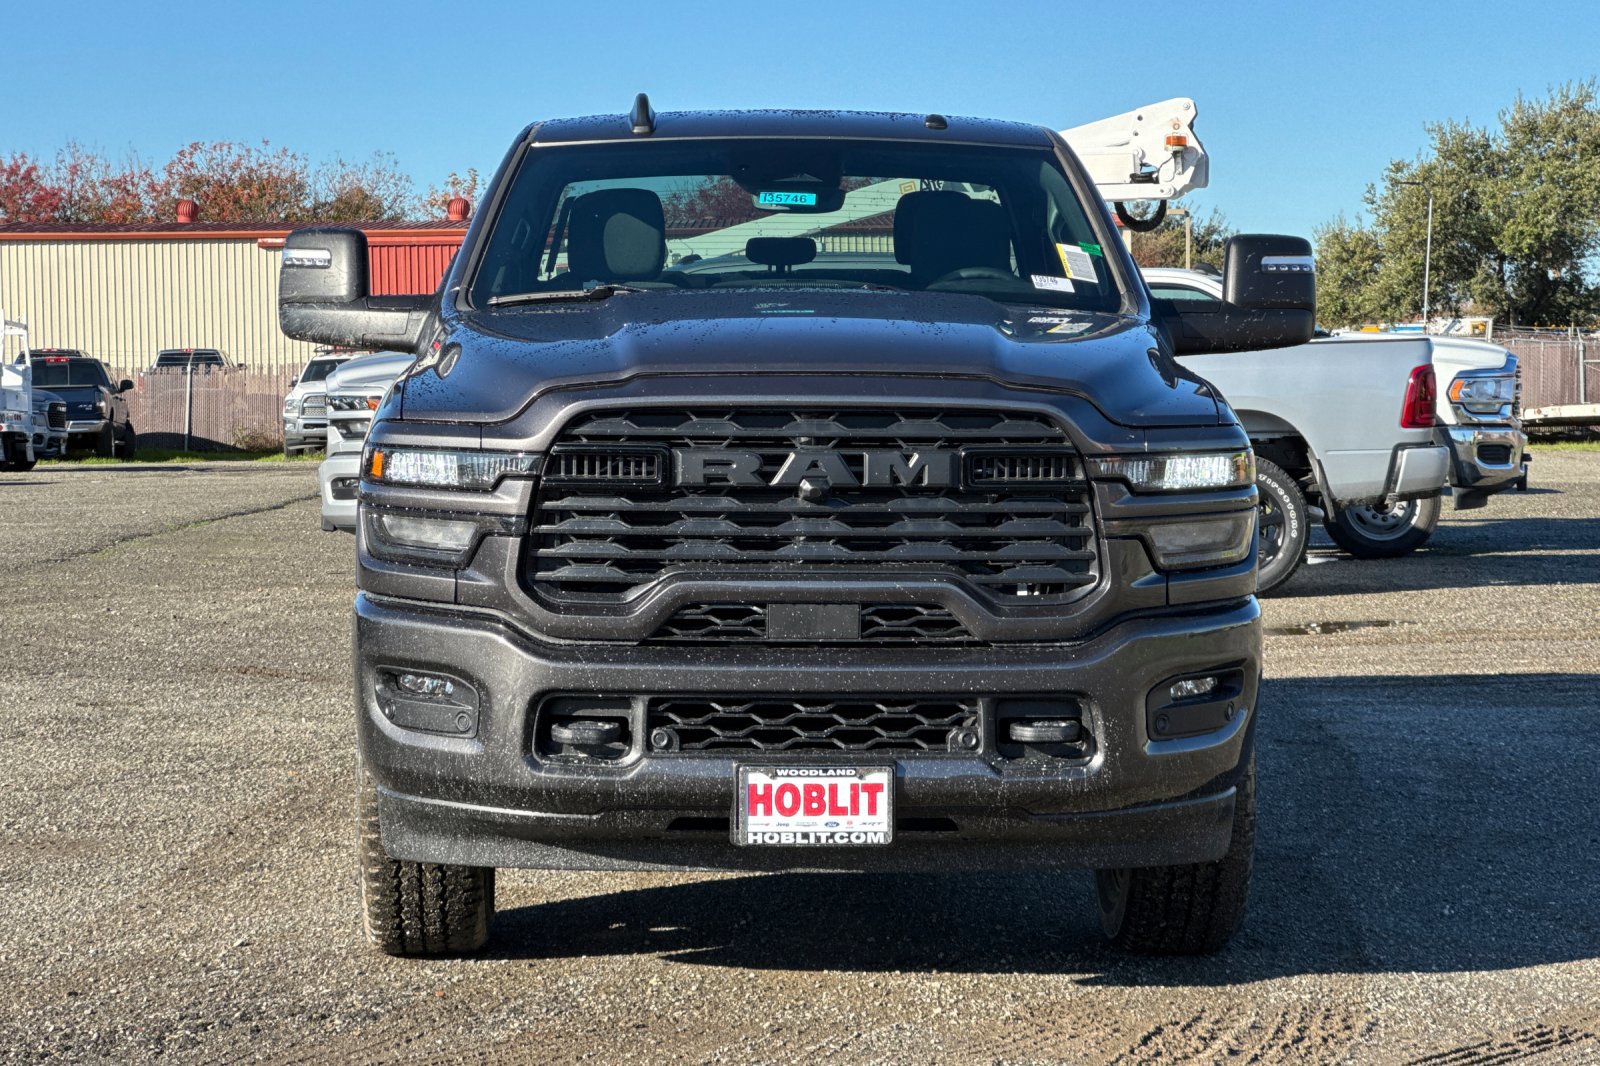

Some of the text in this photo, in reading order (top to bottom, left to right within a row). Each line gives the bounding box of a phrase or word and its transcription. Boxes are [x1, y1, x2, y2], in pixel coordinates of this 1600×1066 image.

[674, 449, 950, 487] RAM
[777, 768, 856, 777] WOODLAND
[748, 782, 884, 817] HOBLIT
[748, 832, 885, 844] HOBLIT.COM
